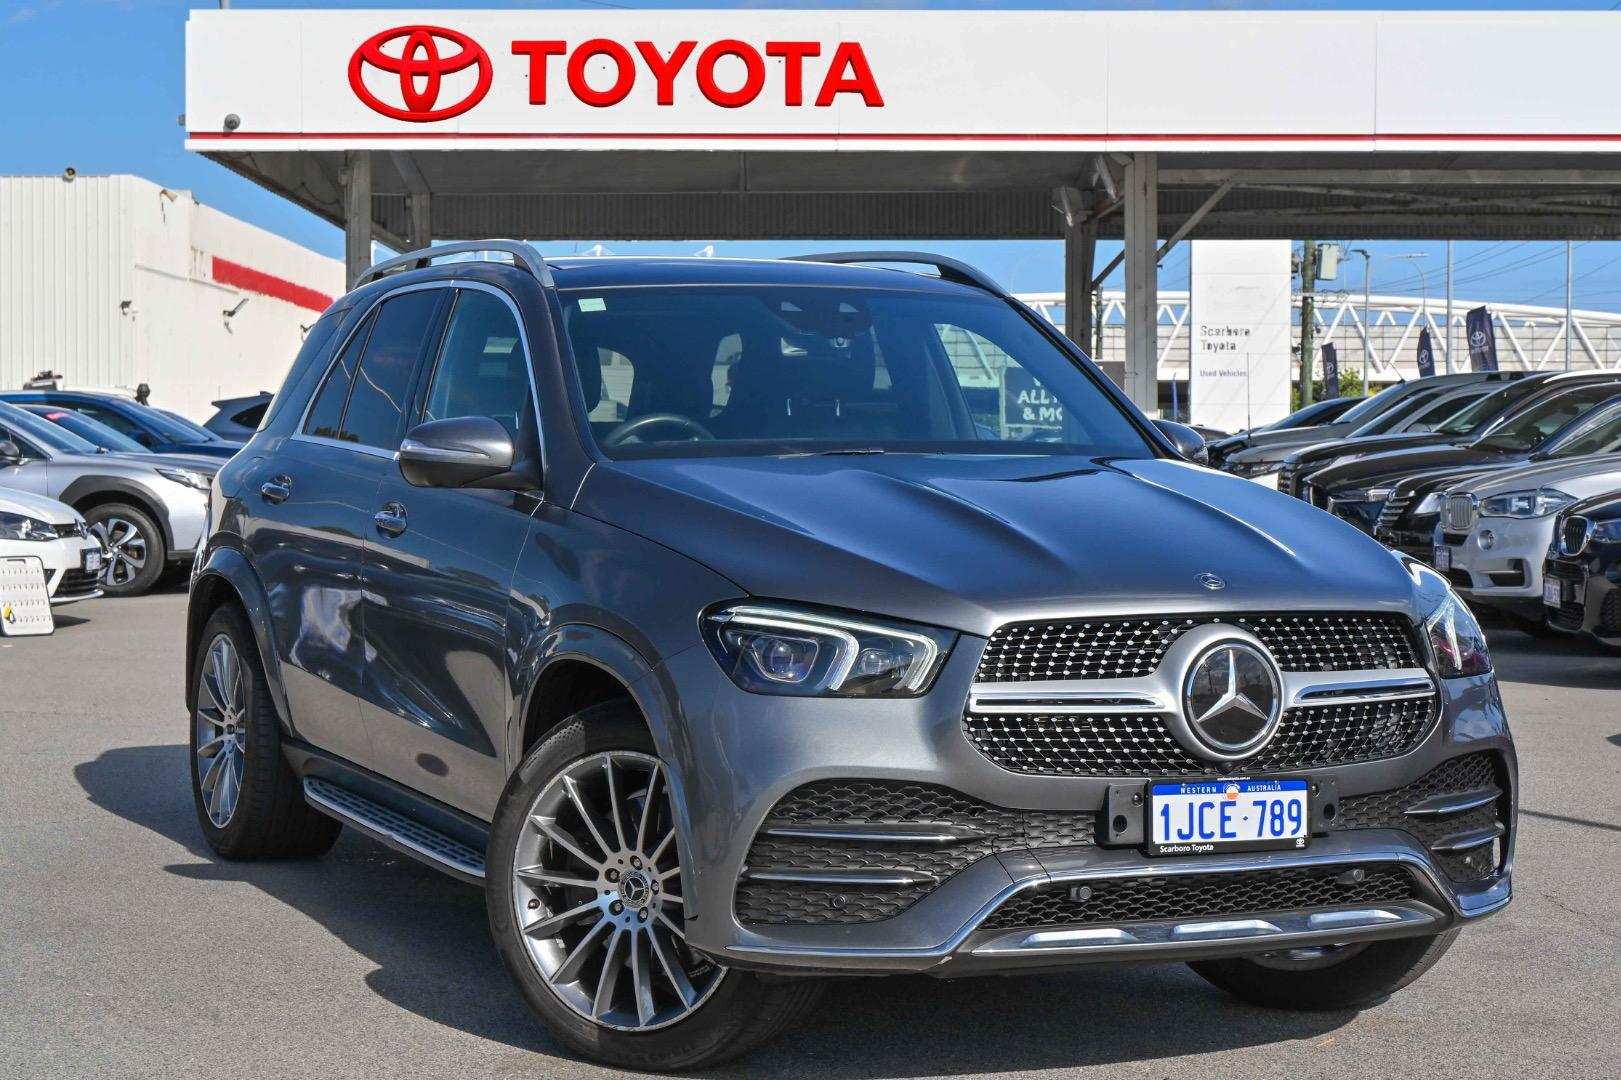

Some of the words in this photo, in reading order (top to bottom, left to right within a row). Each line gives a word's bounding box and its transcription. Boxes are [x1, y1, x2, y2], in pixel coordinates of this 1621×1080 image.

[511, 38, 885, 108] TOYOTA
[1200, 339, 1236, 353] Toyota
[1017, 389, 1050, 404] ALL
[1022, 406, 1035, 420] &
[1180, 786, 1217, 794] WESTERN
[1247, 784, 1281, 792] AUSTRALIA
[1160, 800, 1237, 841] 1JCE
[1252, 798, 1302, 838] 789
[1160, 845, 1190, 853] Scarboro
[1191, 843, 1214, 852] Toyota
